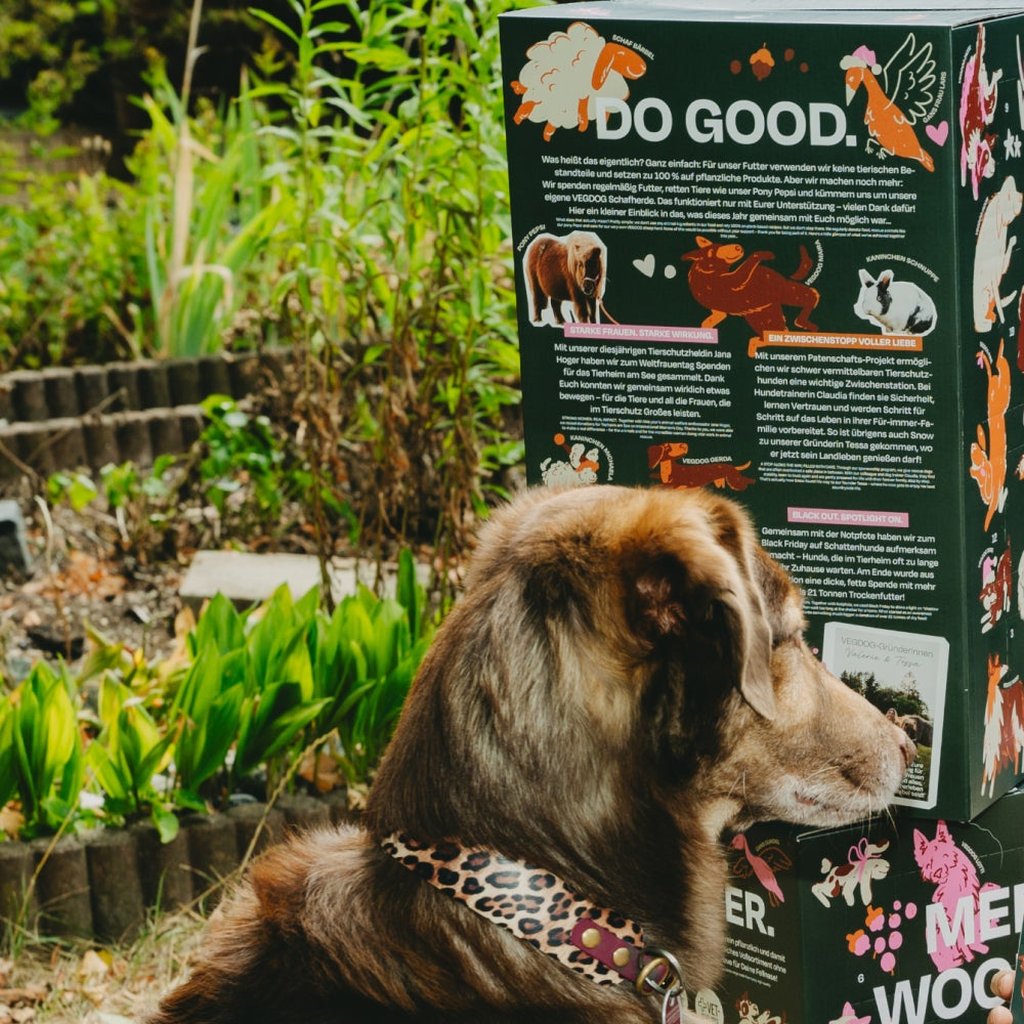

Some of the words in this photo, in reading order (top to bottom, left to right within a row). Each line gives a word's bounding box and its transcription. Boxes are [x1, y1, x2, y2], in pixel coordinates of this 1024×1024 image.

[595, 97, 673, 142] DO
[686, 99, 857, 146] GOOD.
[541, 156, 560, 164] Was
[560, 156, 582, 164] heißt
[583, 157, 598, 165] das
[599, 157, 645, 168] eigentlich?
[645, 159, 667, 167] Ganz
[668, 159, 701, 168] einfach:
[702, 160, 716, 169] Für
[742, 162, 768, 170] Futter
[769, 163, 817, 172] verwenden
[832, 164, 856, 173] keine
[856, 165, 900, 174] tierischen
[900, 166, 916, 174] Be-
[554, 169, 596, 177] standteile
[596, 170, 613, 178] und
[614, 171, 642, 179] setzen
[654, 172, 671, 180] 100
[671, 172, 680, 180] %
[680, 172, 694, 181] auf
[696, 173, 742, 183] pflanzliche
[743, 174, 783, 184] Produkte.
[784, 176, 804, 184] Aber
[804, 176, 818, 184] wir
[820, 177, 855, 186] machen
[855, 178, 877, 186] noch
[878, 178, 903, 187] mehr:
[557, 182, 592, 191] spenden
[592, 182, 638, 193] regelmäßig
[638, 184, 664, 193] Futter,
[665, 185, 690, 193] retten
[691, 186, 711, 194] Tiere
[752, 188, 773, 197] Pony
[774, 188, 797, 198] Pepsi
[798, 189, 814, 197] und
[815, 189, 855, 198] kümmern
[866, 254, 906, 262] KANINCHEN
[570, 326, 601, 335] STARKE
[602, 328, 638, 336] FRAUEN.
[639, 329, 670, 338] STARKE
[671, 330, 714, 340] WIRKUNG.
[784, 335, 858, 345] ZWISCHENSTOPP
[858, 338, 891, 346] VOLLER
[892, 339, 916, 347] LIEBE
[554, 343, 568, 352] Mit
[599, 345, 647, 357] diesjährigen
[647, 347, 714, 358] Tierschutzheldin
[754, 352, 769, 360] Mit
[808, 354, 895, 365] Patenschafts-Projekt
[896, 357, 932, 368] ermögli-
[682, 456, 709, 465] VEGDOG
[792, 511, 820, 519] BLACK
[821, 512, 839, 520] OUT.
[841, 513, 887, 522] SPOTLIGHT
[857, 973, 865, 983] 6
